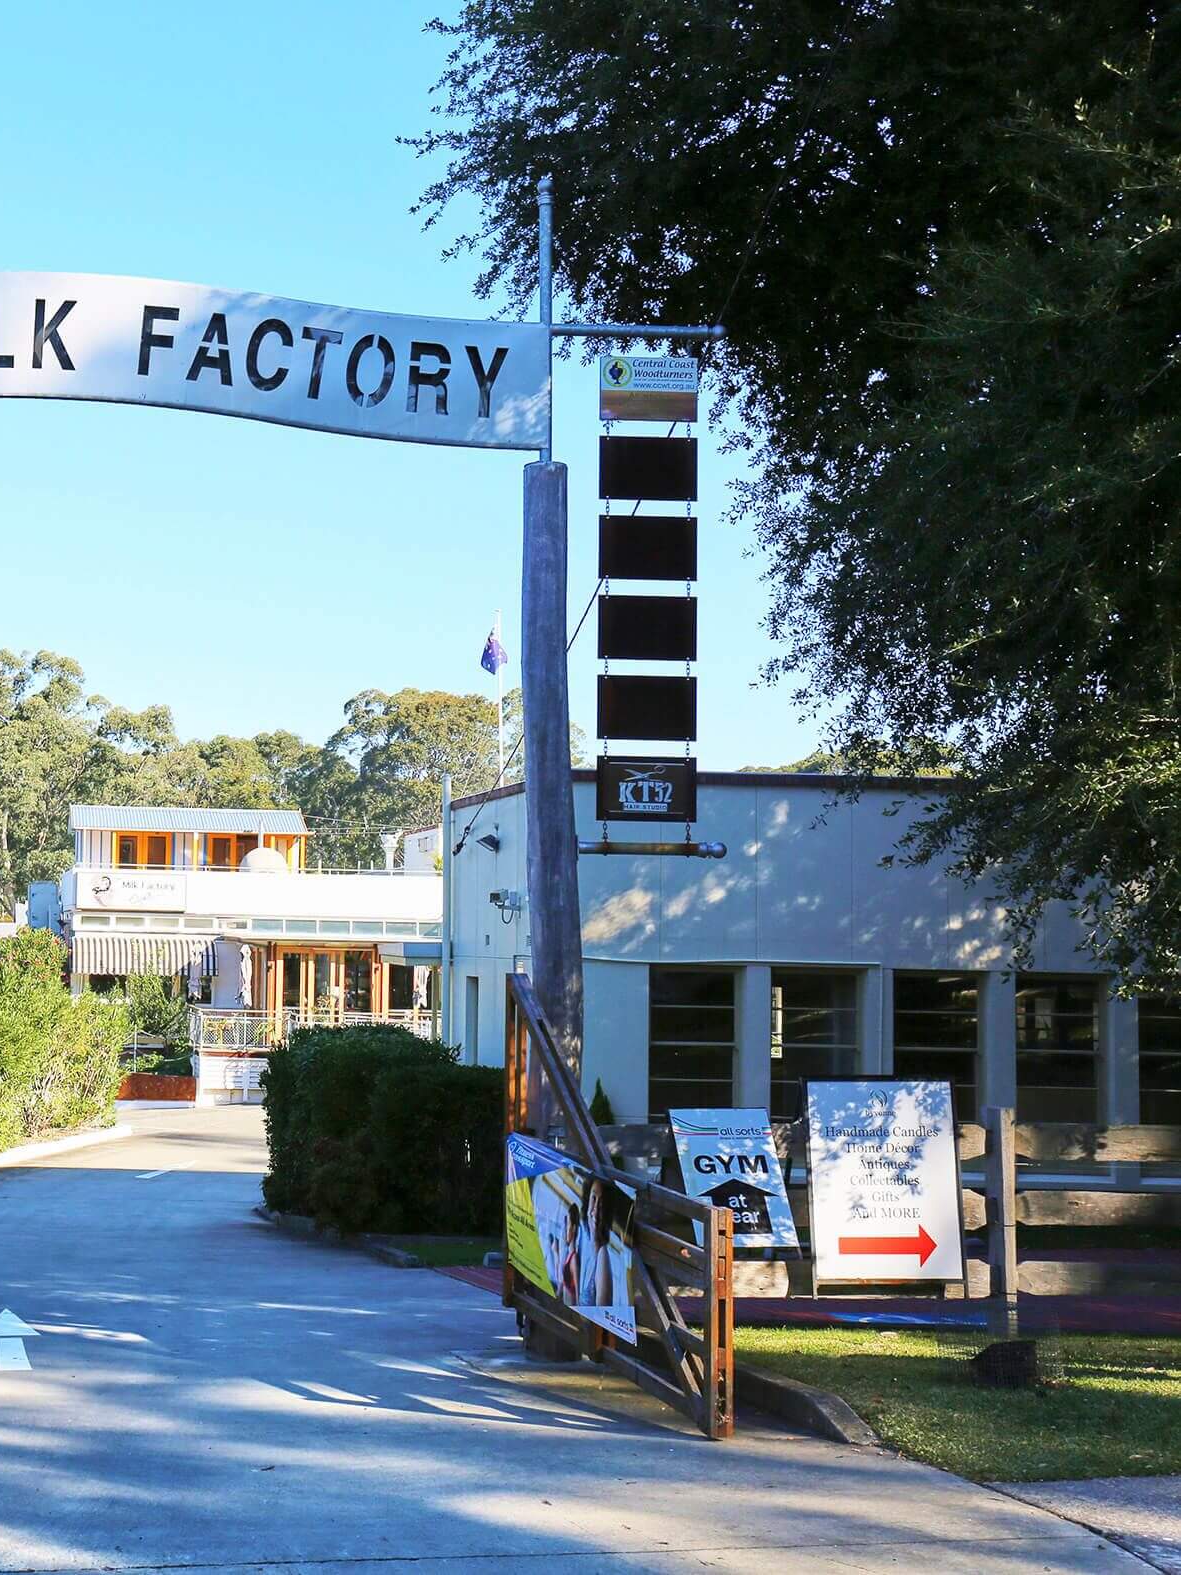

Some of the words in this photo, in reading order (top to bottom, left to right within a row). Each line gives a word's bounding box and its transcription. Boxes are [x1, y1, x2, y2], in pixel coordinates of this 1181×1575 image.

[137, 305, 509, 418] FACTORY
[633, 359, 667, 368] Central
[669, 360, 695, 369] Coast
[634, 370, 693, 379] Woodturners
[720, 1127, 734, 1136] all
[735, 1127, 761, 1136] sorts
[825, 1126, 890, 1138] Handmade
[892, 1126, 939, 1138] Candles
[846, 1142, 882, 1154] Home
[885, 1141, 920, 1154] Décor
[693, 1154, 769, 1175] GYM
[860, 1159, 910, 1171] Antiques
[850, 1174, 920, 1186] Collectables
[728, 1195, 748, 1208] at
[872, 1191, 900, 1202] Gifts
[732, 1211, 760, 1224] ear
[853, 1207, 877, 1219] And
[880, 1207, 921, 1219] MORE
